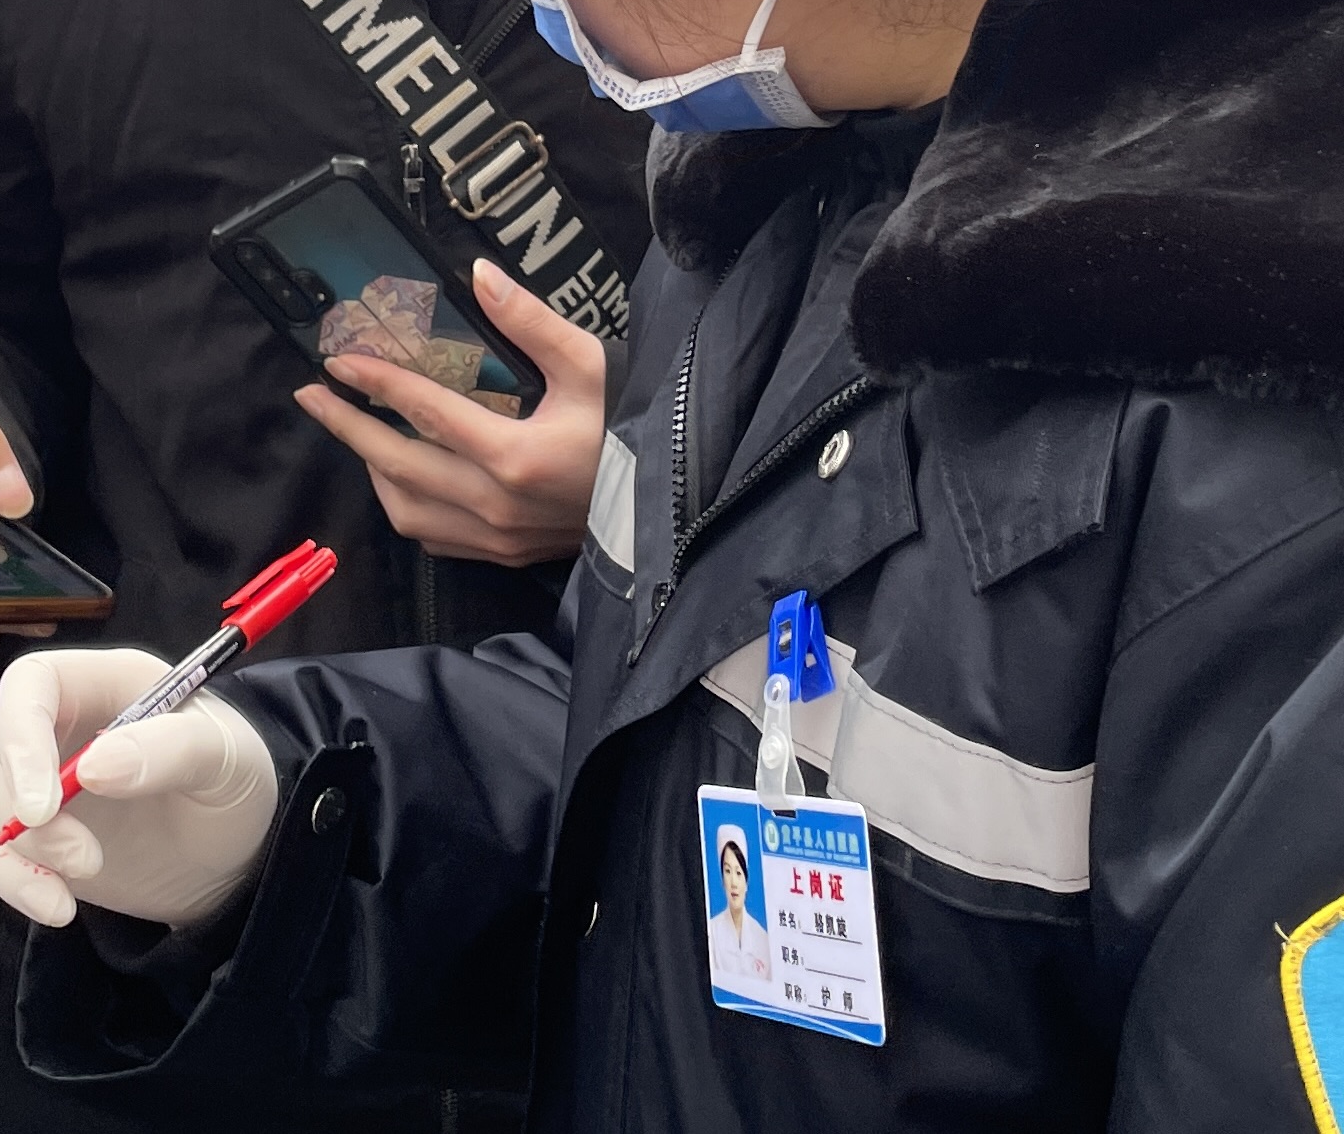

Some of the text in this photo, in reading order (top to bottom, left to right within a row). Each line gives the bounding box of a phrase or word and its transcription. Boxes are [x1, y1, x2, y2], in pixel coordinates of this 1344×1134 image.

[577, 247, 630, 339] LIM
[790, 867, 844, 901] 上岗证
